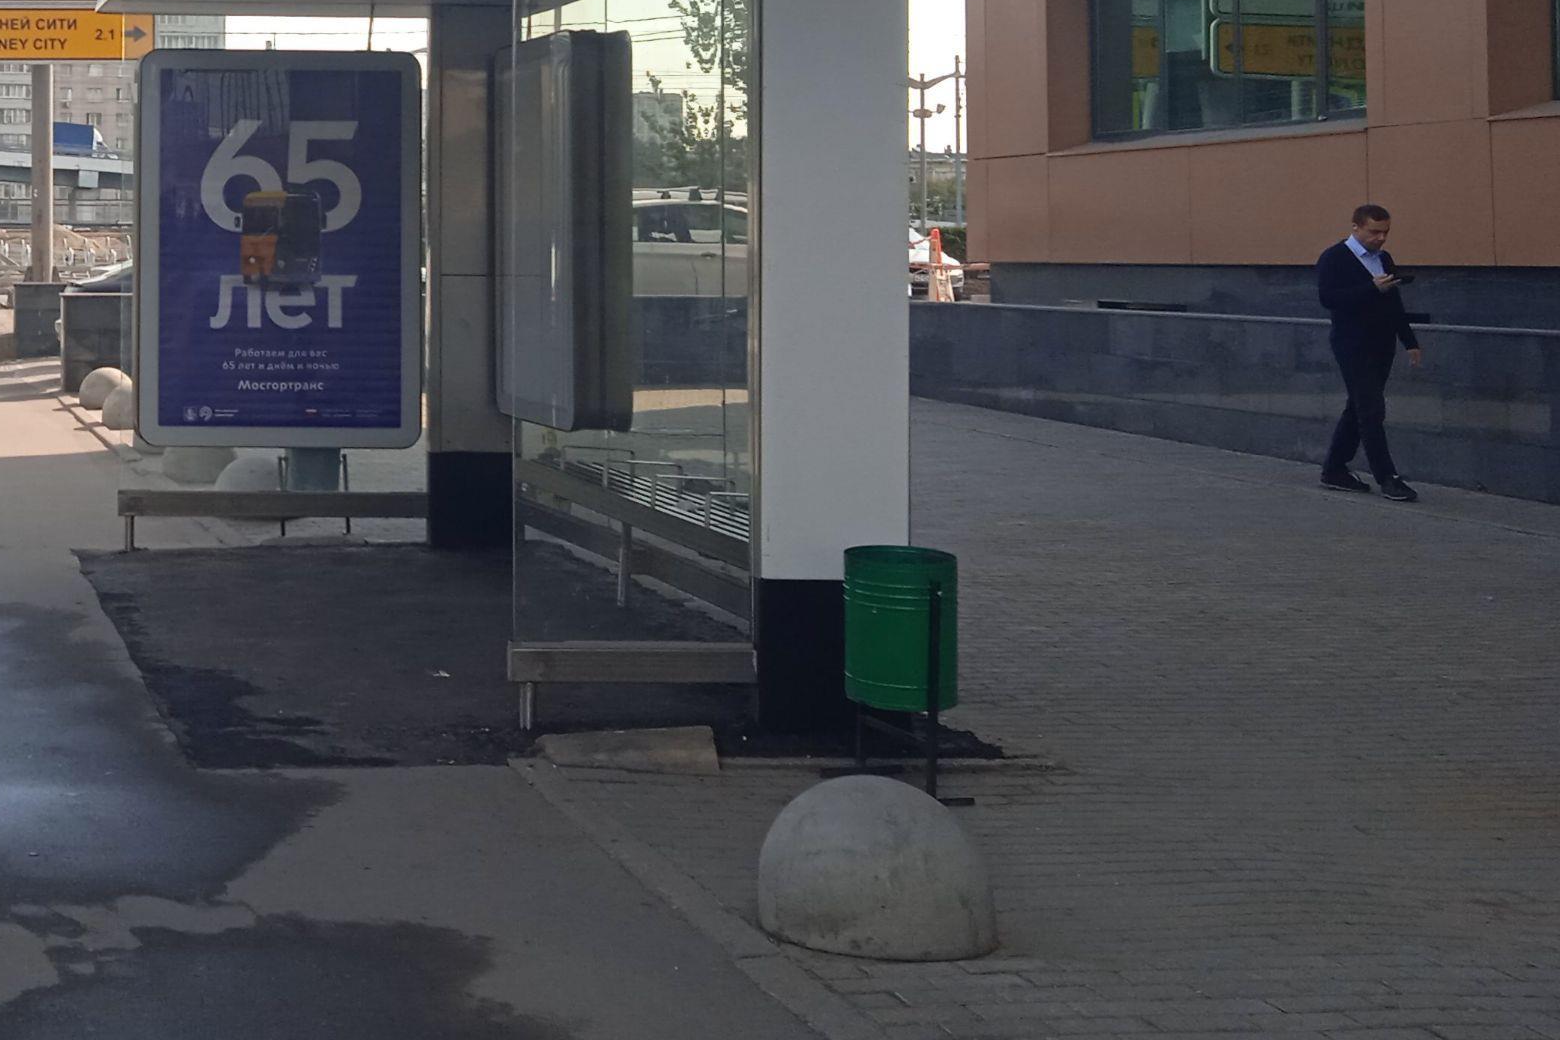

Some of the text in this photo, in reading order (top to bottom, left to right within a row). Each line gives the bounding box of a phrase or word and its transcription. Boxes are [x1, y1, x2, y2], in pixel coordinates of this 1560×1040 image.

[35, 19, 77, 30] СИТИ
[95, 29, 115, 40] 2.1
[33, 38, 67, 50] CITY
[200, 119, 362, 234] 65
[222, 361, 236, 370] 65
[237, 380, 325, 392] Мосгортранс
